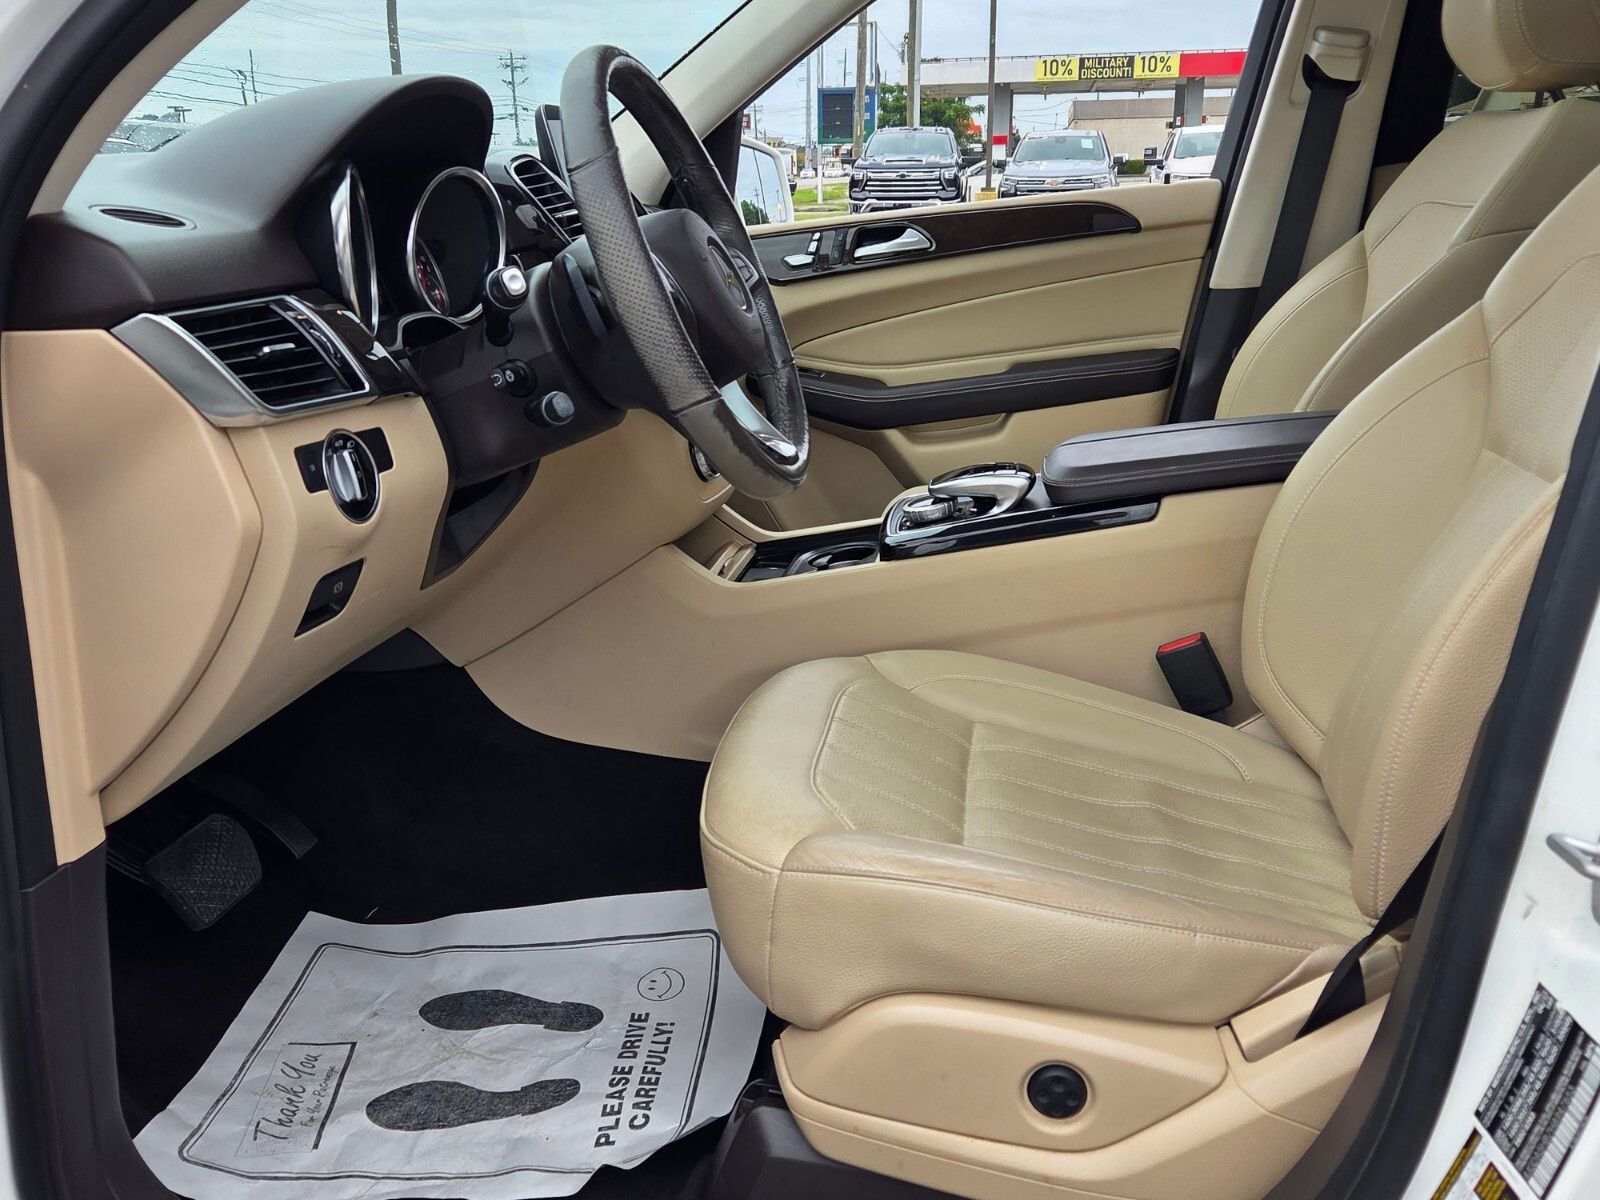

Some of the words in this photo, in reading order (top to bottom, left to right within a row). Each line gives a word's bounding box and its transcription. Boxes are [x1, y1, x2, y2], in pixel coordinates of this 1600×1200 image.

[1042, 59, 1073, 76] 10%
[1084, 57, 1130, 68] MILITARY
[1140, 55, 1172, 73] 10%
[1081, 66, 1132, 78] DISCOUNT!
[594, 1065, 635, 1148] PLEASE
[617, 1012, 650, 1059] DRIVE
[628, 1022, 676, 1131] CAREFULLY!
[253, 1083, 306, 1141] Thank
[280, 1054, 322, 1080] You
